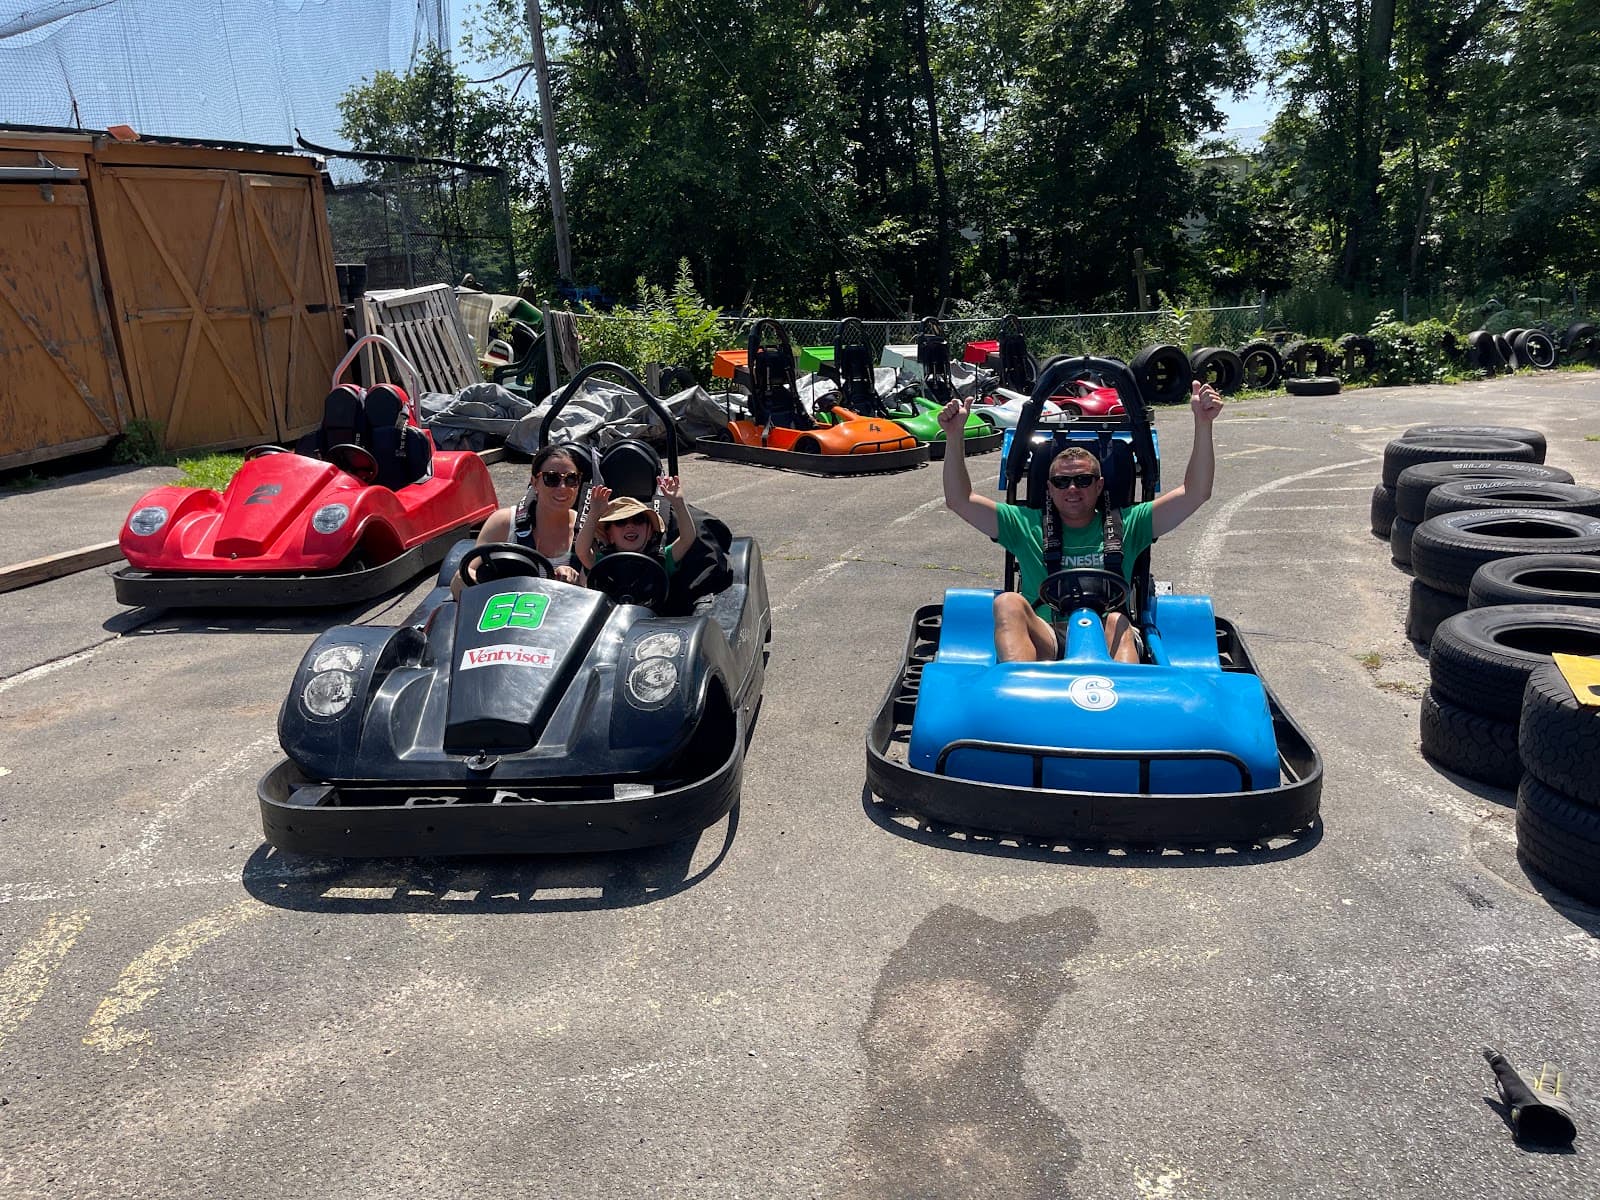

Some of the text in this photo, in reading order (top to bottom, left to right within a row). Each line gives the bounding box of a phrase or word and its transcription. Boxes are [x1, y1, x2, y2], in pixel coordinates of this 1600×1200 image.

[244, 484, 282, 505] 2
[1060, 553, 1104, 567] ENESE
[477, 591, 551, 632] 69
[468, 648, 551, 665] Ventvisor
[1068, 675, 1118, 711] 6
